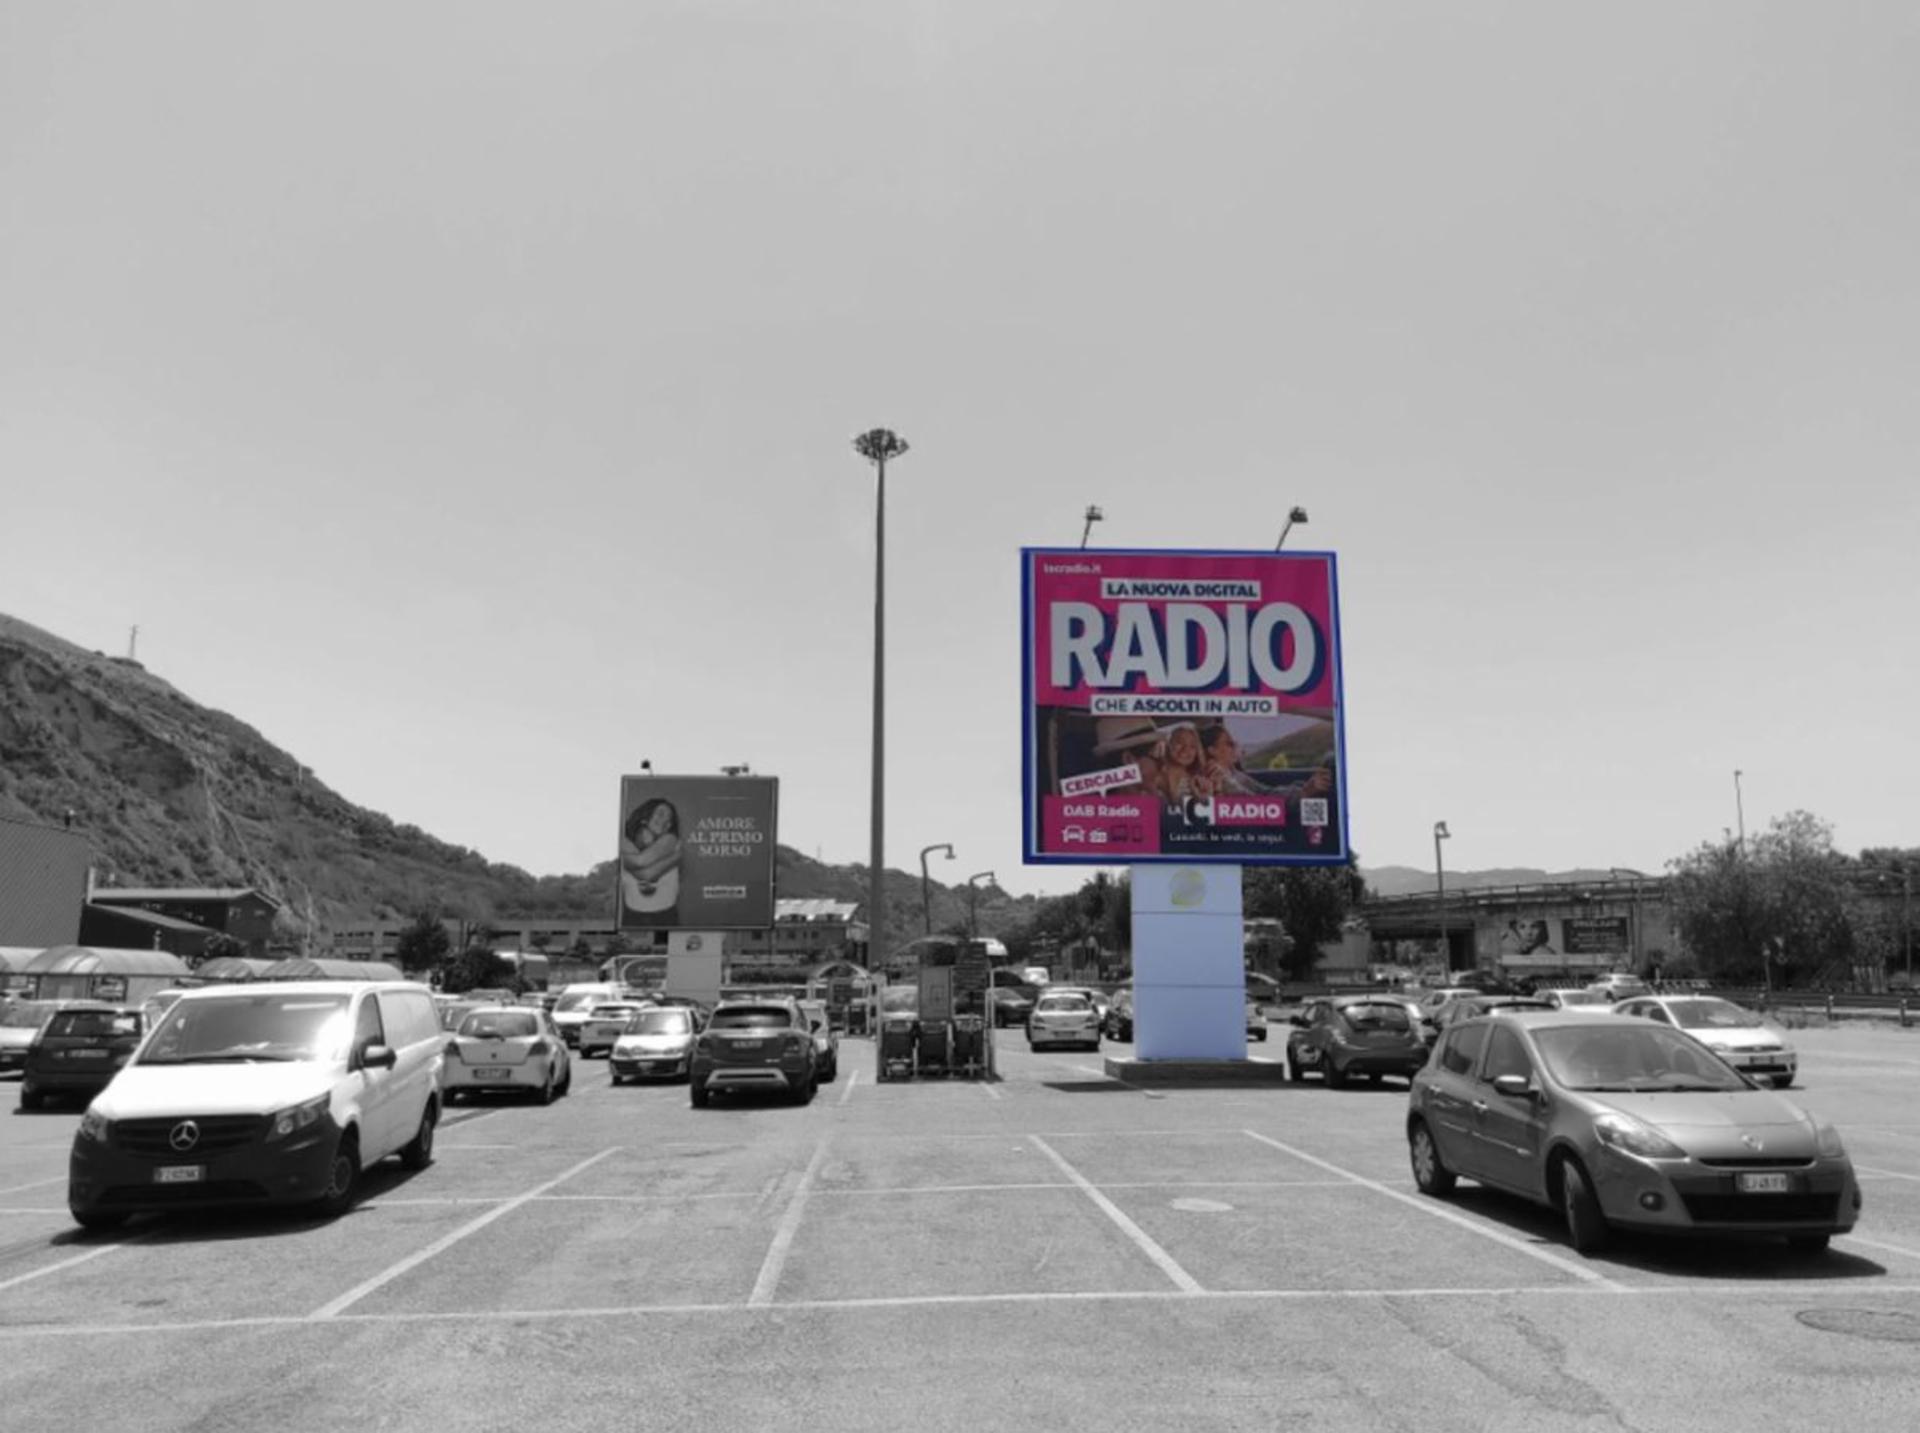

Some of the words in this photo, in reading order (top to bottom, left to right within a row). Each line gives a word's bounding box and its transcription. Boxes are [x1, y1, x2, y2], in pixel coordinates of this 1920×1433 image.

[1107, 583, 1129, 597] LA
[1132, 583, 1190, 598] NUOVA
[1194, 584, 1257, 598] DIGITAL
[1051, 601, 1317, 691] RADIO
[1095, 699, 1128, 712] CHE
[1133, 699, 1200, 712] ASCOLTI
[1205, 700, 1222, 712] IN
[1226, 700, 1272, 713] AUTO
[1065, 768, 1137, 793] CERCALA!
[1063, 805, 1095, 817] DAB
[1098, 804, 1140, 817] Radio
[1218, 803, 1281, 819] RADIO
[697, 816, 755, 830] AMORE
[687, 831, 706, 844] AL
[709, 831, 763, 844] PRIMO
[698, 844, 752, 857] SORSO
